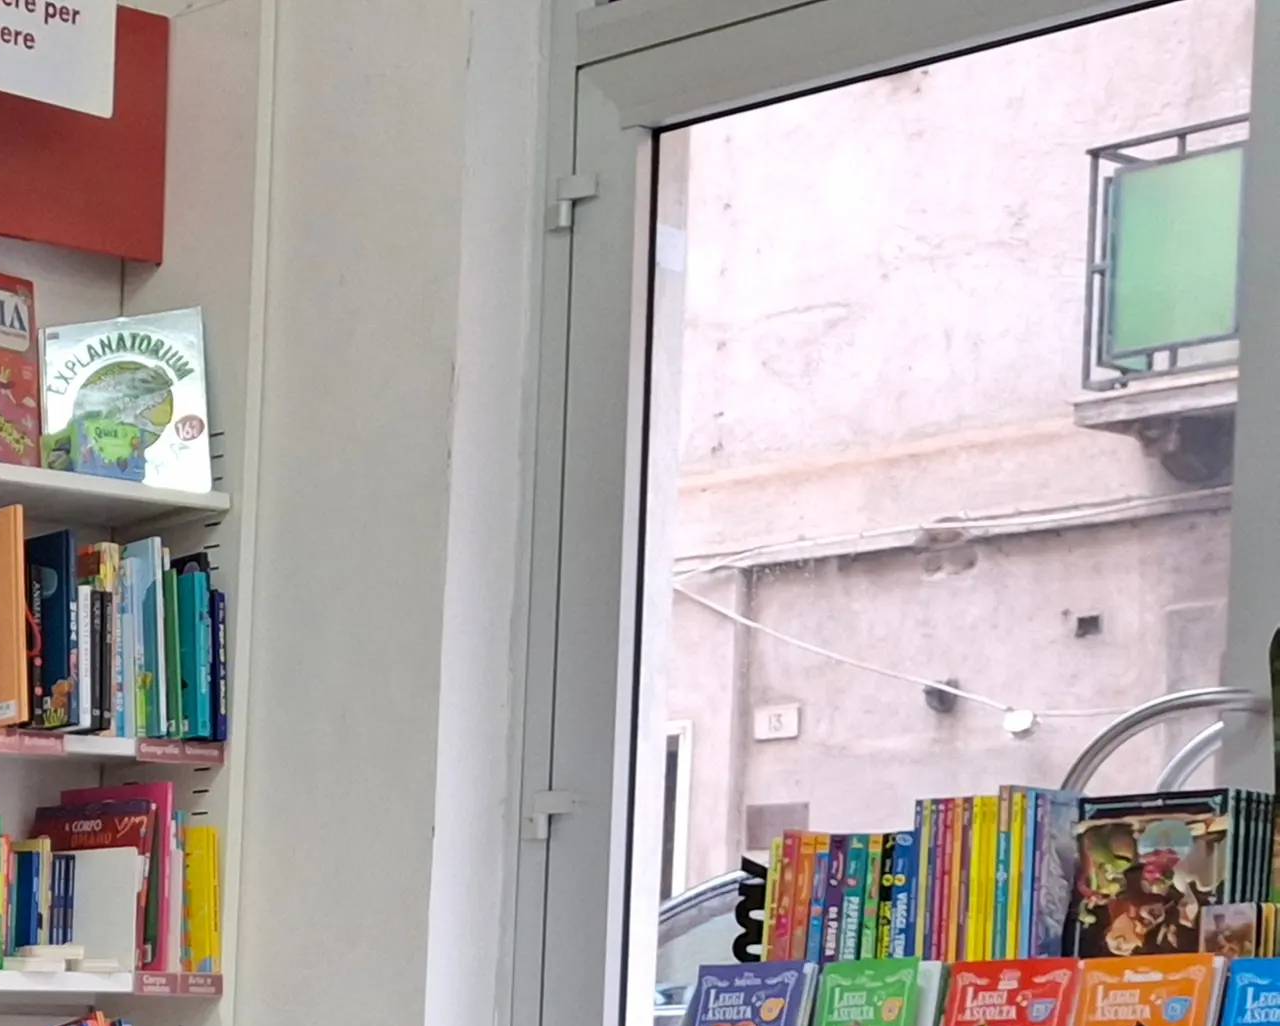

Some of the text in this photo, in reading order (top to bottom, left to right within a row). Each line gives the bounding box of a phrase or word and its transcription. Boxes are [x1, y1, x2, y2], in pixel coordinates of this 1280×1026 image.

[44, 3, 80, 25] per
[46, 331, 196, 397] EXPLANATORIUM
[709, 988, 744, 1008] LEGGI
[833, 988, 867, 1007] LEGGI
[966, 985, 1008, 1005] LEGGI
[1097, 985, 1140, 1004] LEGGI
[707, 1006, 752, 1021] ASCOLTA
[831, 1005, 875, 1021] ASCOLTA
[964, 1004, 1017, 1021] ASCOLTA
[1095, 1004, 1152, 1021] ASCOLTA
